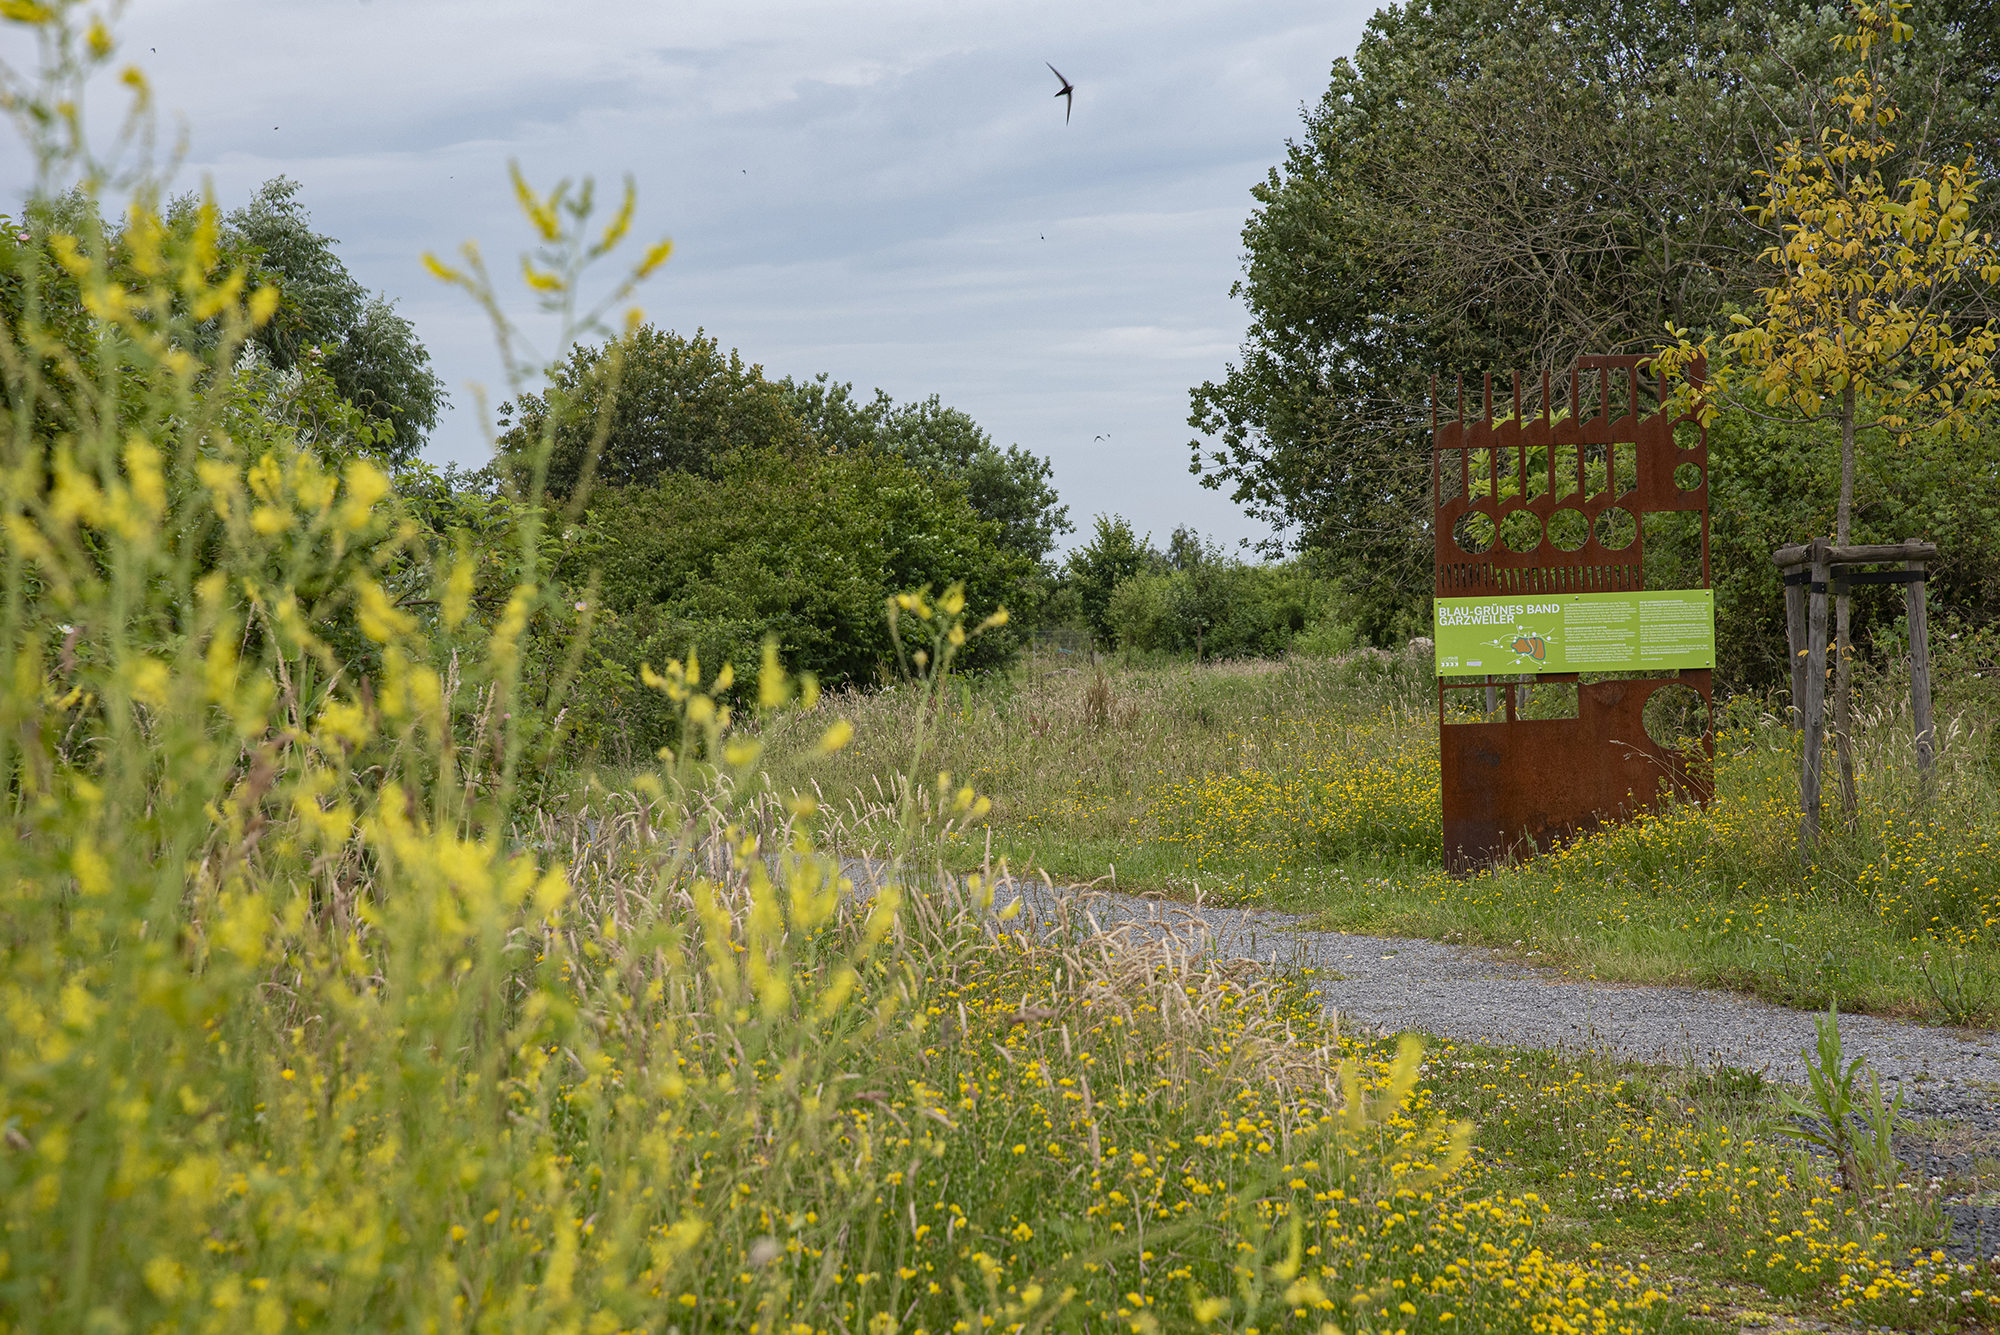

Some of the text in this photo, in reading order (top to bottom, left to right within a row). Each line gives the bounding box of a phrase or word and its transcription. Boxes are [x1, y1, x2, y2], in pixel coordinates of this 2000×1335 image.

[1438, 604, 1524, 617] BLAU-GRÜNES
[1526, 604, 1560, 615] BAND
[1439, 614, 1515, 626] GARZWEILER
